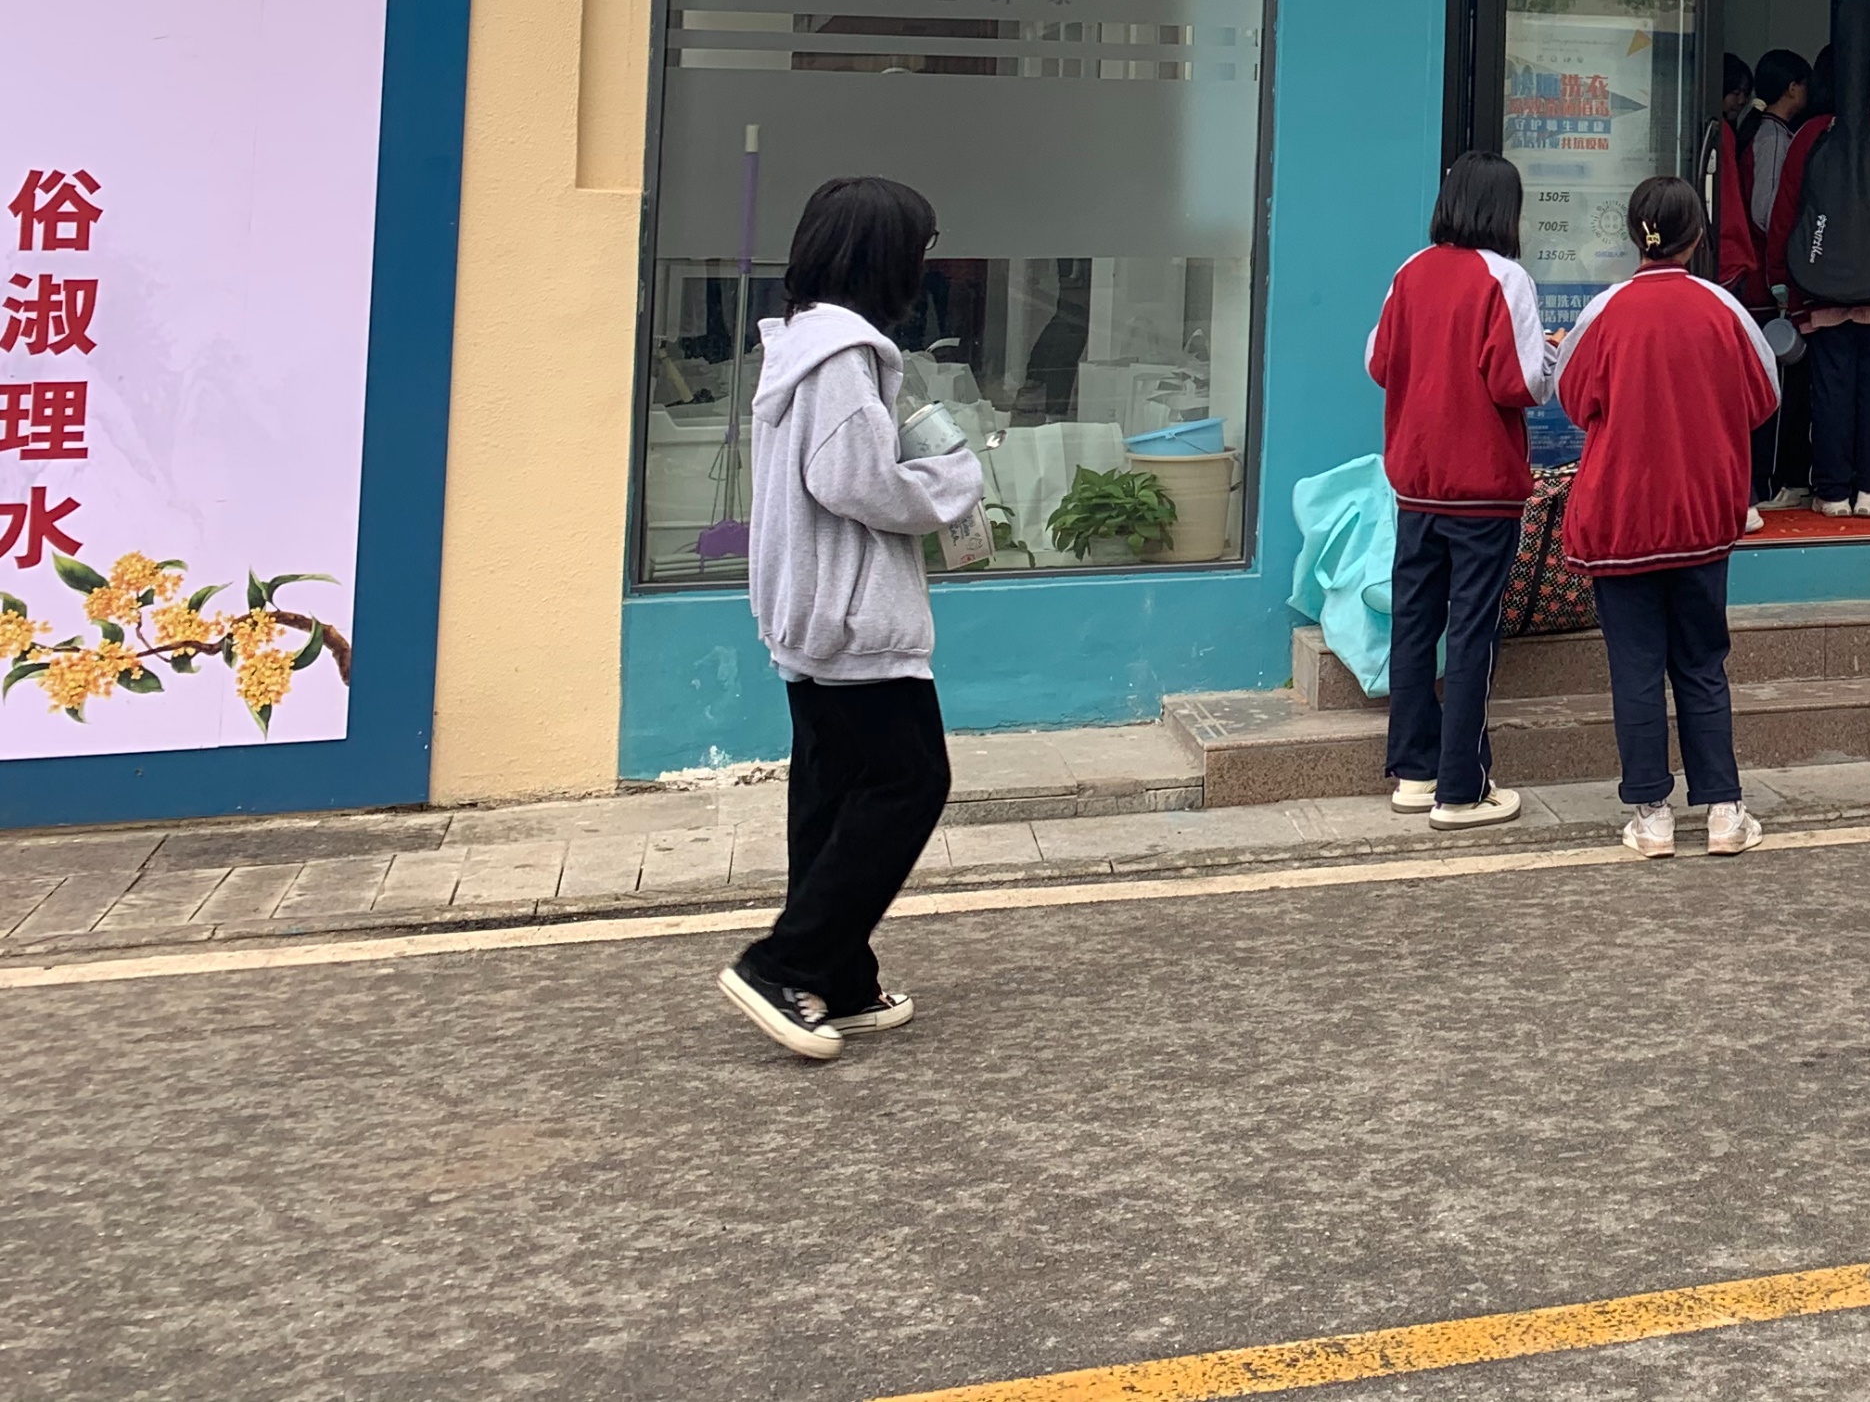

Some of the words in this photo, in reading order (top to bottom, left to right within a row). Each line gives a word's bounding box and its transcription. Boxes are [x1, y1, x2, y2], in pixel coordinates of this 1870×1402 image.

[1538, 191, 1571, 204] 150元
[1537, 220, 1569, 233] 700元
[1537, 249, 1576, 262] 1350元
